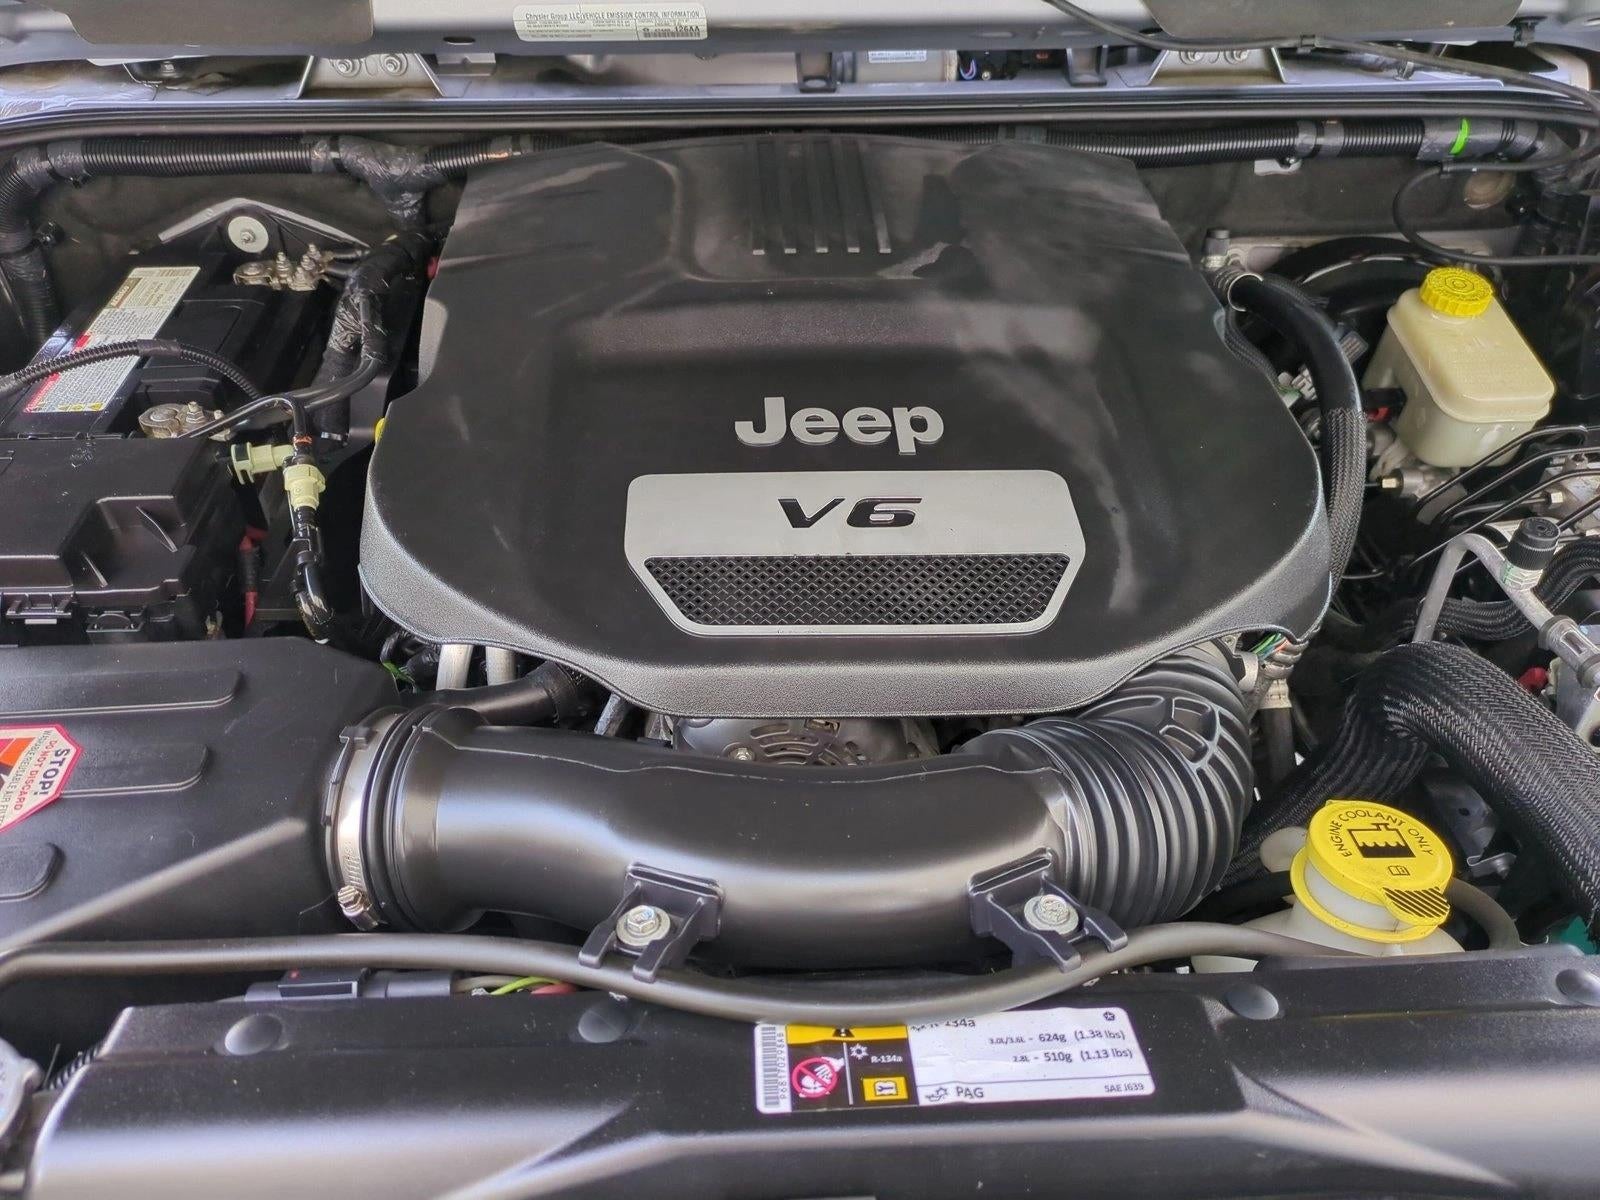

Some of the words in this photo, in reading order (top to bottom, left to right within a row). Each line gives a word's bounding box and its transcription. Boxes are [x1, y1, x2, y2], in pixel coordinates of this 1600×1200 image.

[734, 396, 945, 456] Jeep
[777, 497, 923, 529] V6
[35, 750, 49, 767] NOT
[34, 748, 70, 796] STOP!
[14, 770, 39, 811] DISCARD
[1338, 809, 1407, 827] COOLANT
[1329, 820, 1353, 858] ENGINE
[1407, 828, 1434, 856] ONLY
[1038, 1033, 1067, 1043] 624g
[1074, 1031, 1103, 1041] (1.38
[1105, 1029, 1126, 1040] lbs)
[870, 1054, 903, 1064] R-134a
[1043, 1052, 1073, 1063] 510g
[1080, 1050, 1109, 1062] (1.13
[1112, 1048, 1133, 1059] lbs)
[956, 1086, 985, 1099] PAG
[1104, 1084, 1122, 1093] SAE
